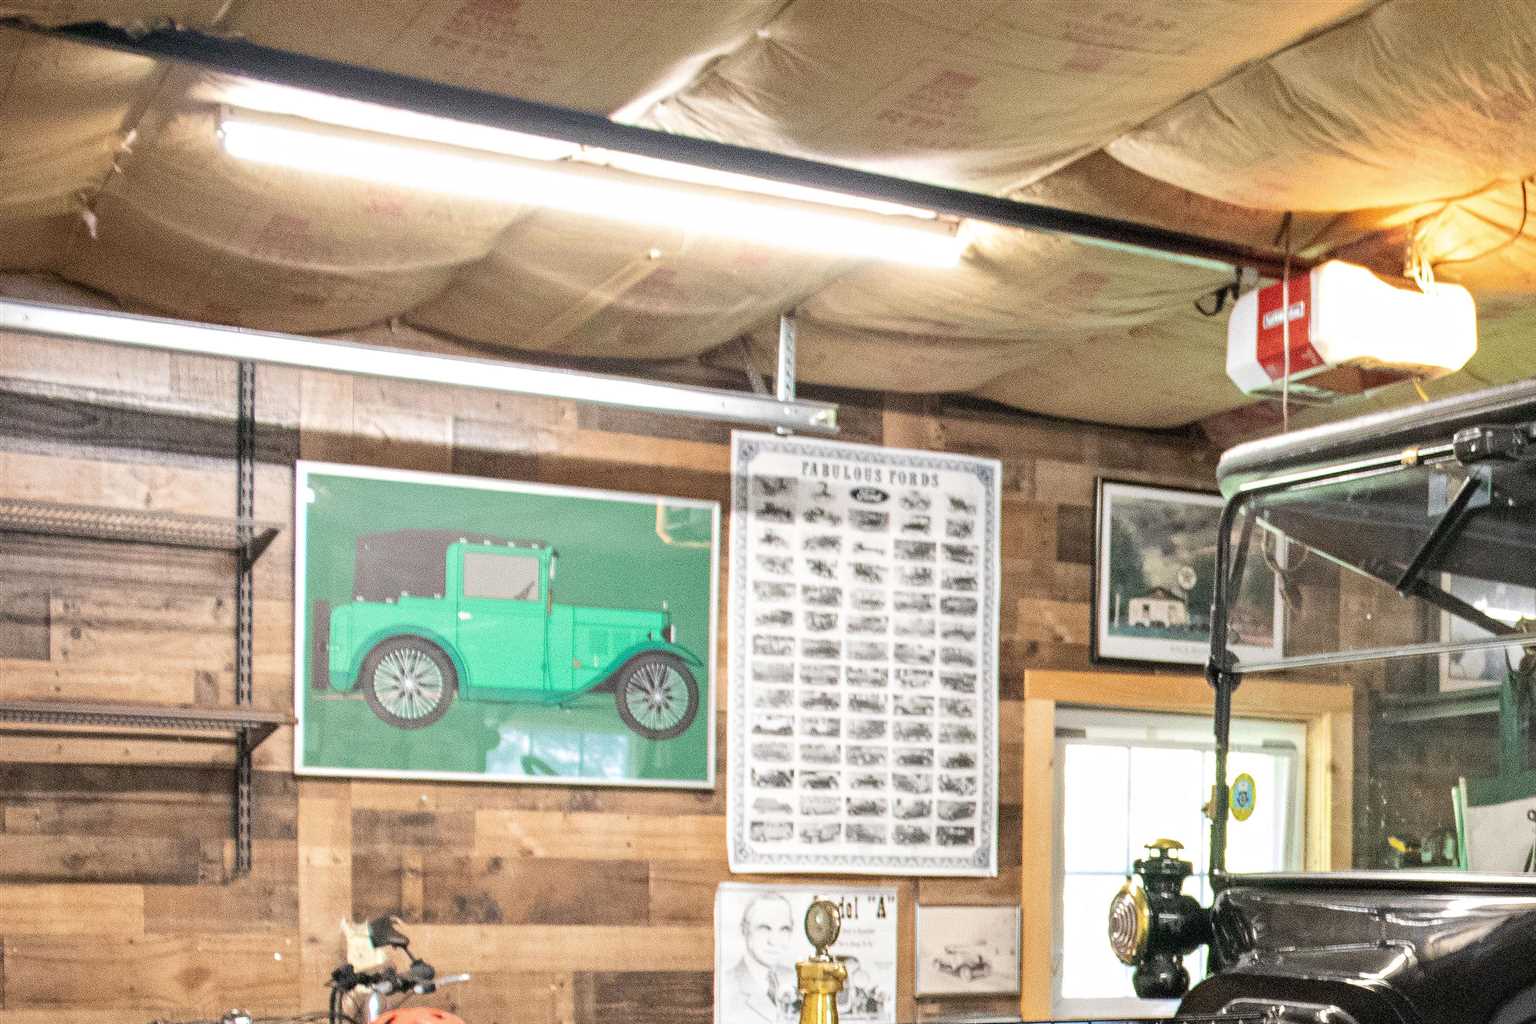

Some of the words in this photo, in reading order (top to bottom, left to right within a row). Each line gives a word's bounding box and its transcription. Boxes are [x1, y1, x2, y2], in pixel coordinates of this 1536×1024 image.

[801, 461, 882, 483] FABULOUS
[888, 470, 940, 487] FORDS
[867, 895, 896, 920] "A"
